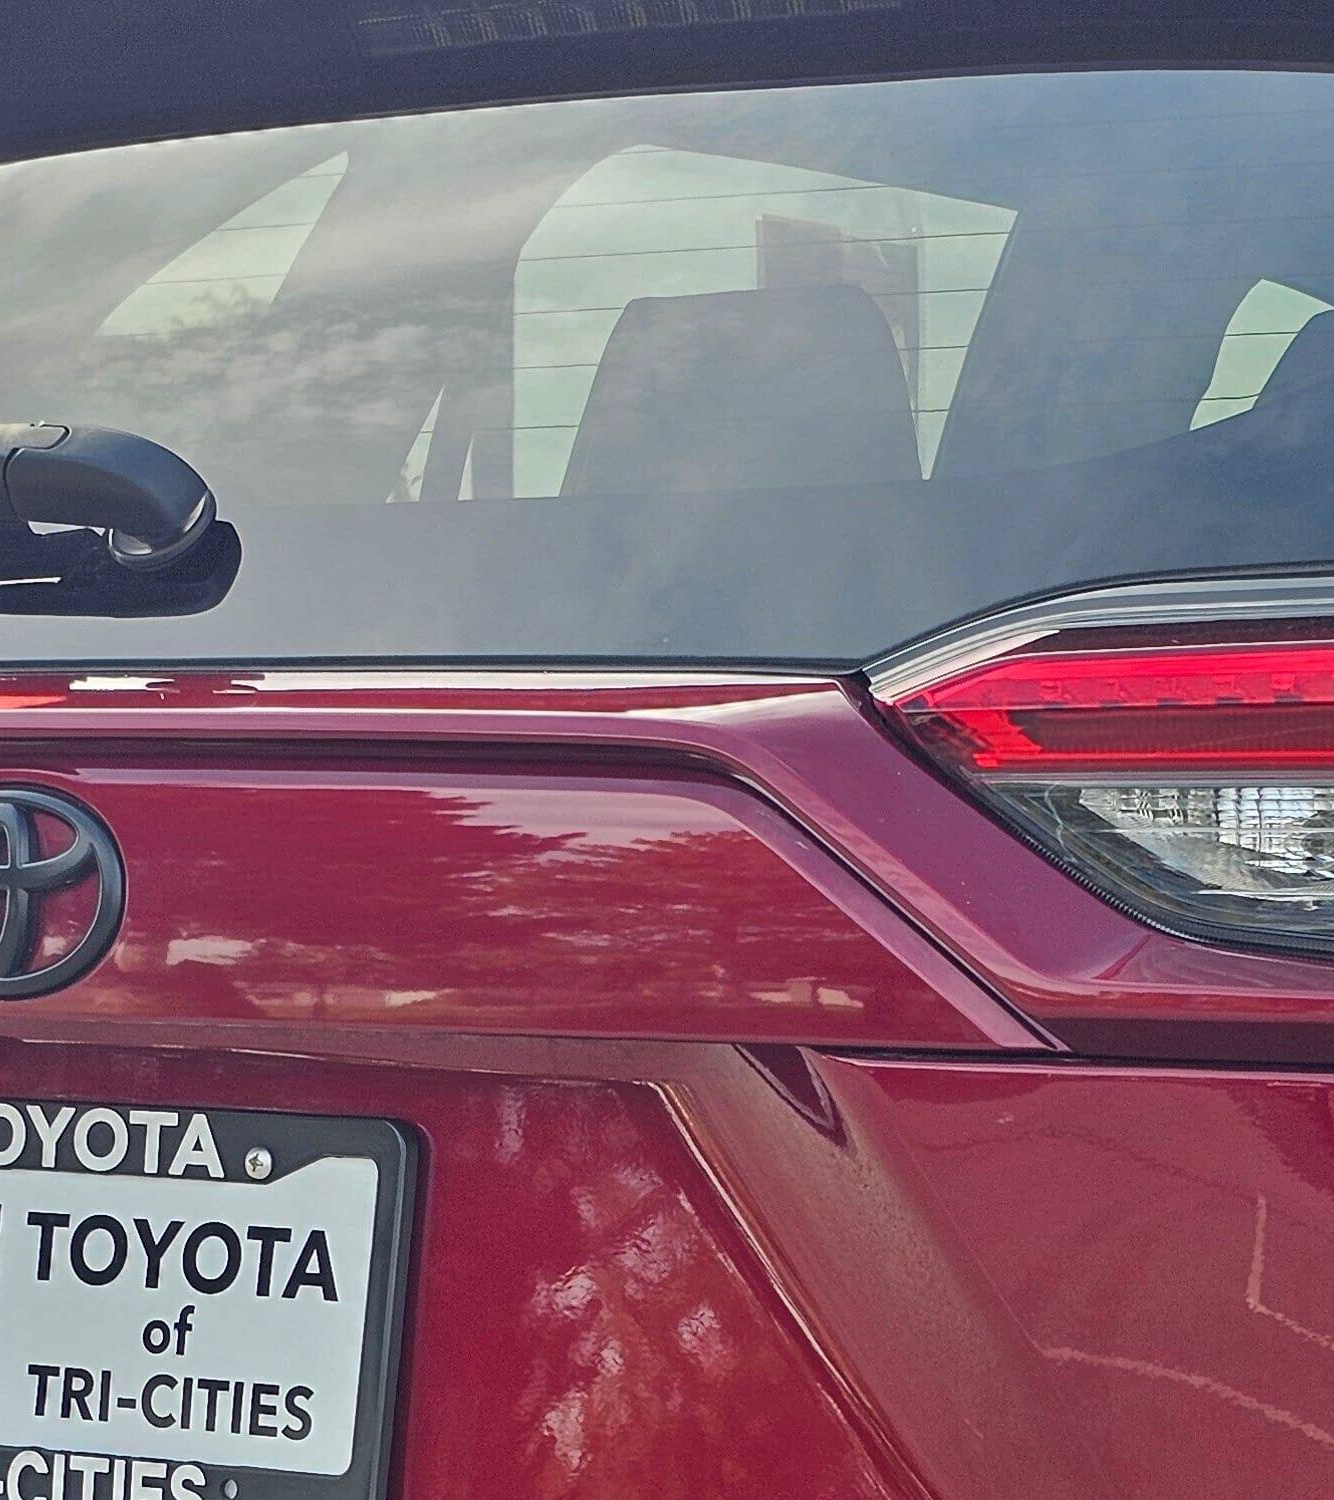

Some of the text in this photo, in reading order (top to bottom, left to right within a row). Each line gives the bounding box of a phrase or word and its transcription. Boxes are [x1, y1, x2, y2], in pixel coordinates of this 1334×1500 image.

[27, 1211, 339, 1302] TOYOTA
[142, 1305, 195, 1356] of
[28, 1364, 314, 1441] TRI-CITIES
